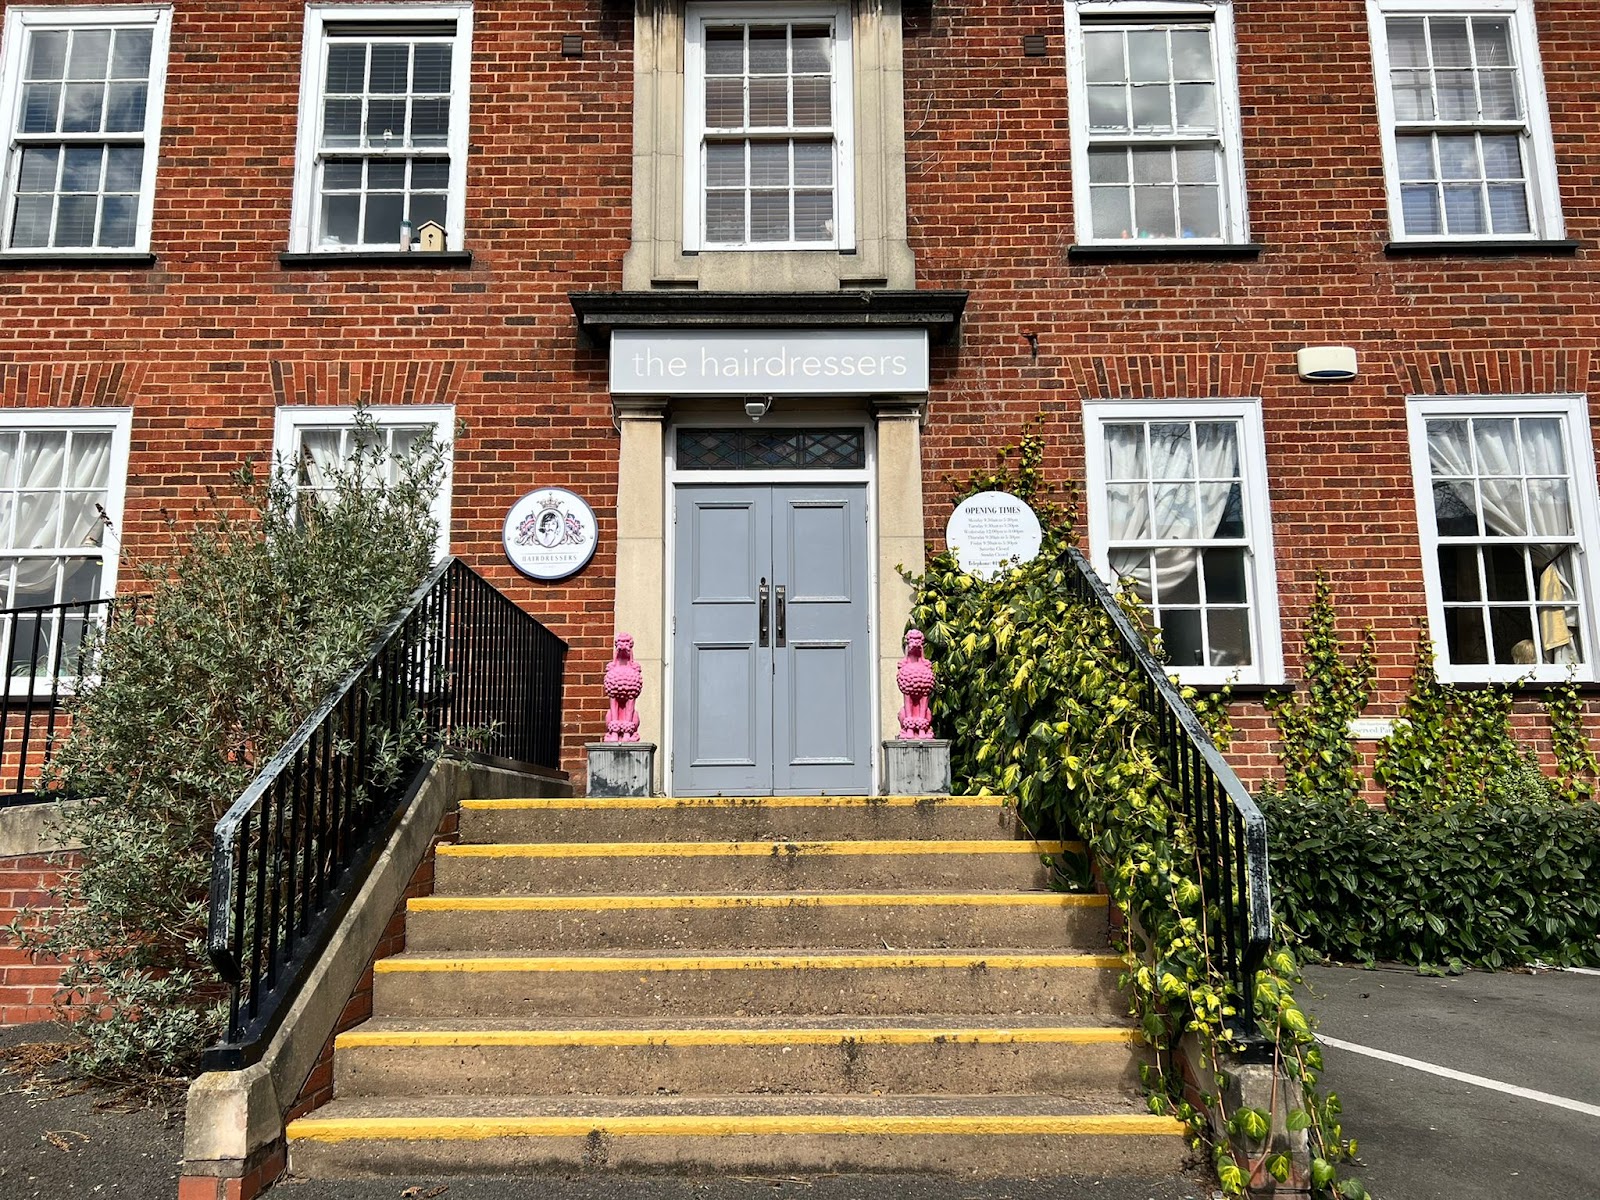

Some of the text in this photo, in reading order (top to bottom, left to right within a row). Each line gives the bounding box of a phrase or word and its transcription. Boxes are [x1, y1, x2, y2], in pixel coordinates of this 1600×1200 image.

[631, 346, 907, 377] the hairdressers
[965, 506, 1021, 514] OPENING TIMES
[521, 554, 578, 562] HAIRDRESSERS
